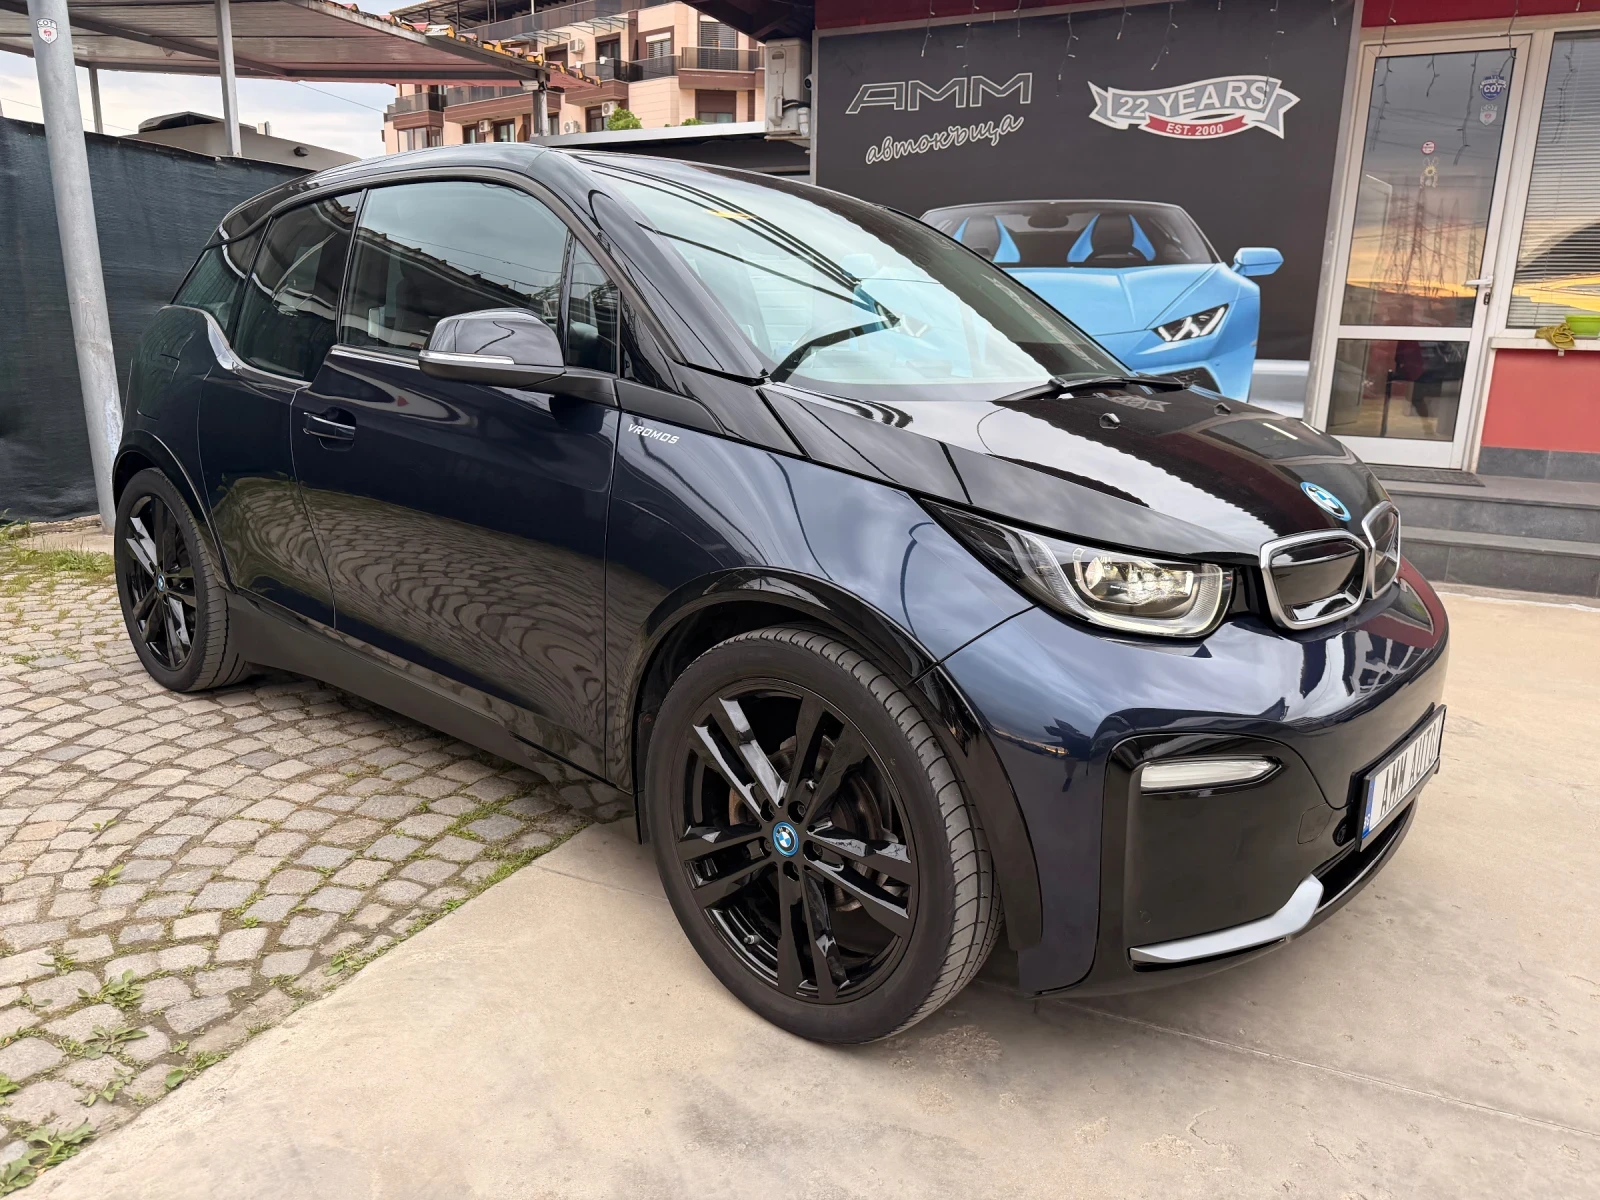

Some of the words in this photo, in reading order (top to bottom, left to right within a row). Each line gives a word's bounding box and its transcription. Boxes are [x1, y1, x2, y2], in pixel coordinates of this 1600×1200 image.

[845, 72, 1033, 114] AMM
[1117, 97, 1149, 117] 22
[1157, 81, 1270, 117] YEARS
[1483, 85, 1501, 93] COT
[865, 113, 1024, 165] автокъща
[1166, 124, 1192, 136] EST.
[1195, 124, 1224, 136] 2000
[627, 423, 680, 444] VROMOS
